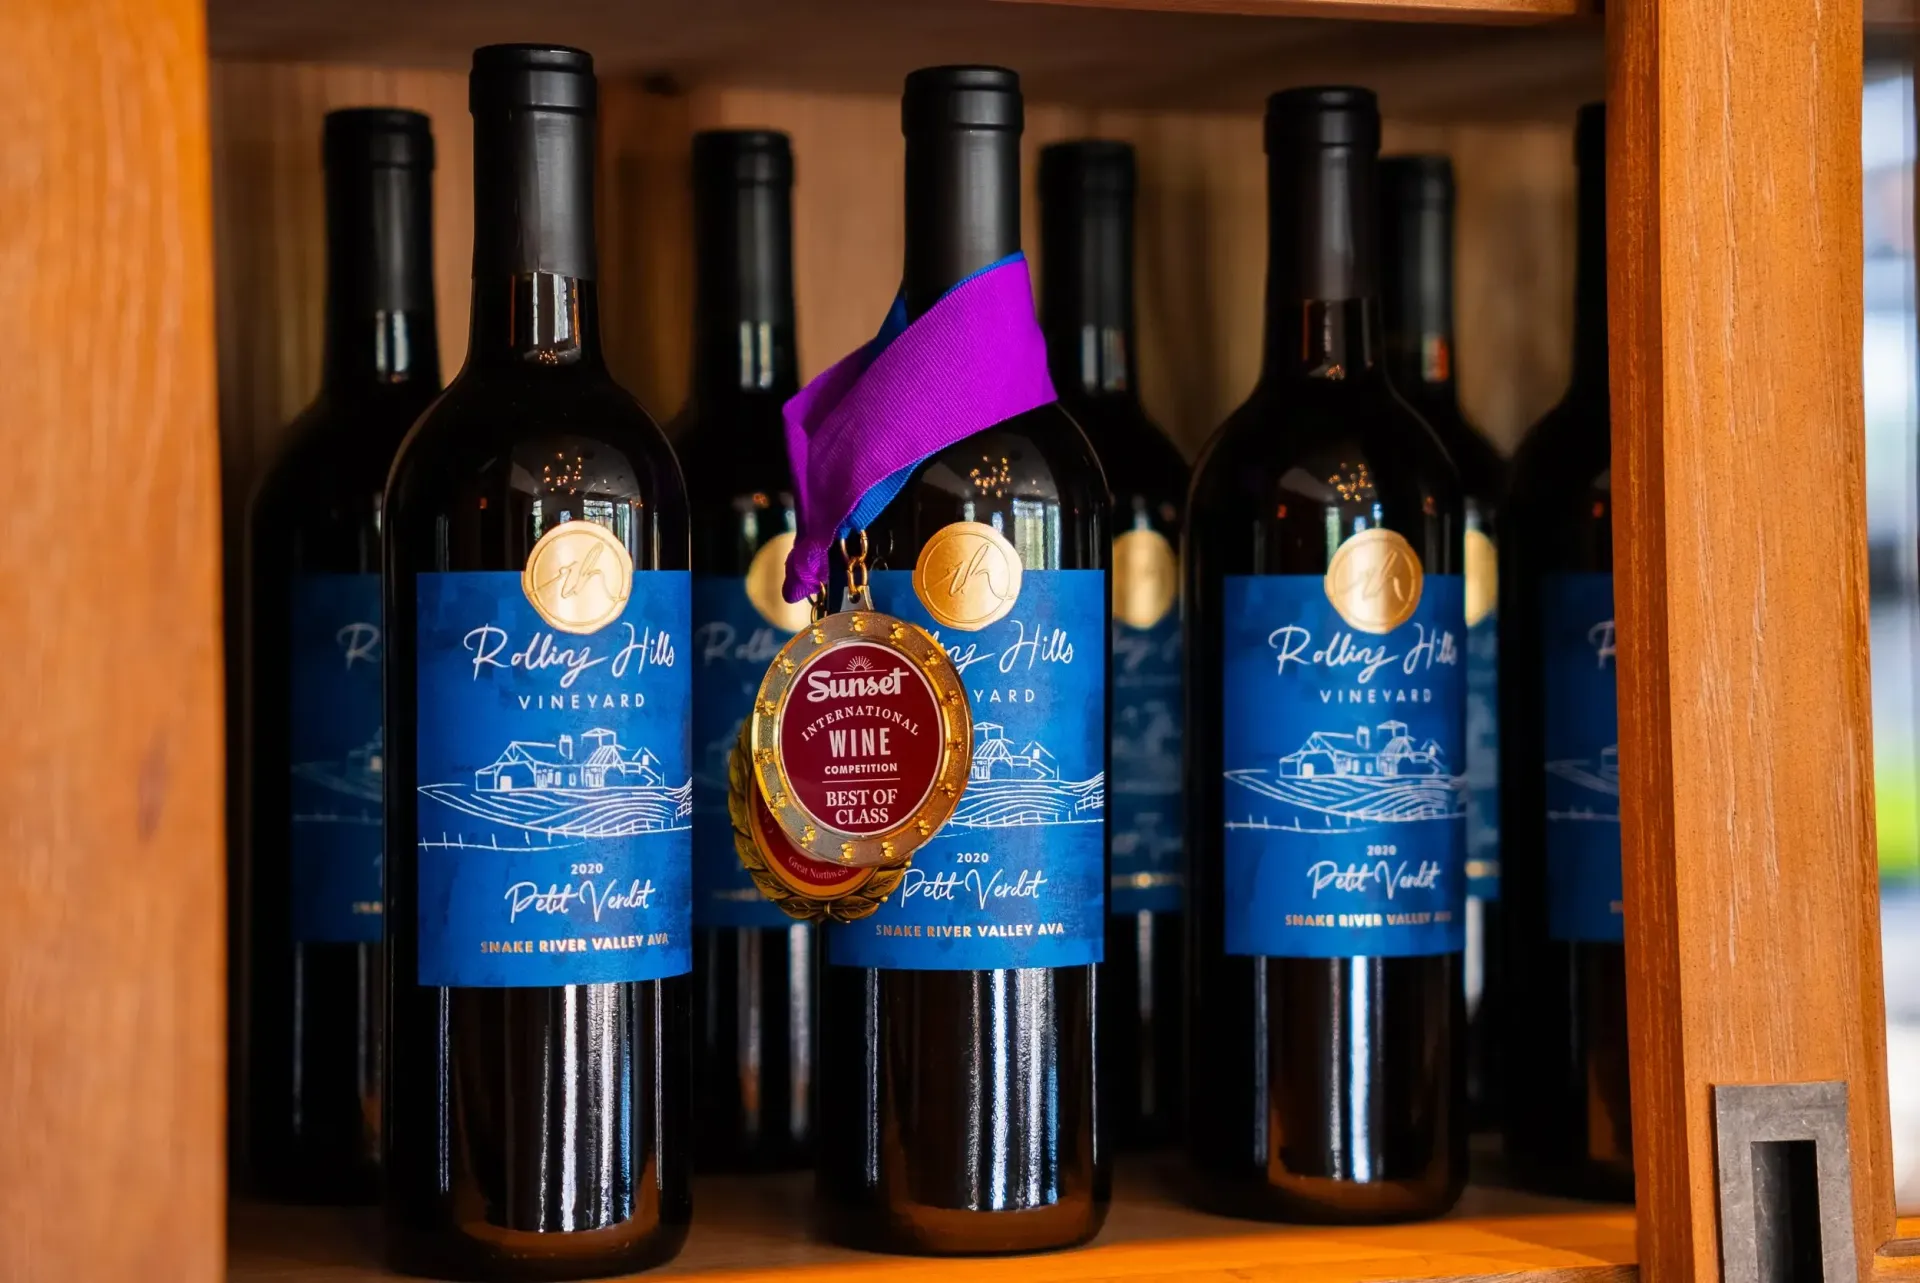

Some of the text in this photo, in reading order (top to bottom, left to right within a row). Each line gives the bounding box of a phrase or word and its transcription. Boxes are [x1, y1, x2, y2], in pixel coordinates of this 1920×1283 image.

[463, 622, 675, 688] Rolling Hills
[999, 620, 1074, 673] Hills
[1268, 622, 1457, 684] Rolling Hills
[807, 667, 910, 702] Sunset
[518, 693, 645, 710] VINEYARD
[973, 689, 1035, 703] YARD
[1319, 688, 1432, 704] VINEYARD
[801, 705, 919, 741] INTERNATIONAL
[829, 728, 891, 758] WINE
[824, 763, 898, 775] COMPETITION
[826, 788, 898, 807] BEST OF
[835, 808, 889, 825] CLASS
[788, 856, 848, 880] Great Northwest
[956, 852, 989, 863] 2020
[570, 863, 603, 875] 2020
[901, 868, 1048, 910] Petit Verdot
[1306, 860, 1441, 900] Petit Verdot
[504, 879, 656, 923] Petit Verdot
[876, 922, 1064, 937] SNAKE RIVER VALLEY AVA
[1285, 914, 1334, 927] SNAKE
[1338, 914, 1382, 927] RIVER
[480, 932, 669, 953] SNAKE RIVER VALLEY AVA
